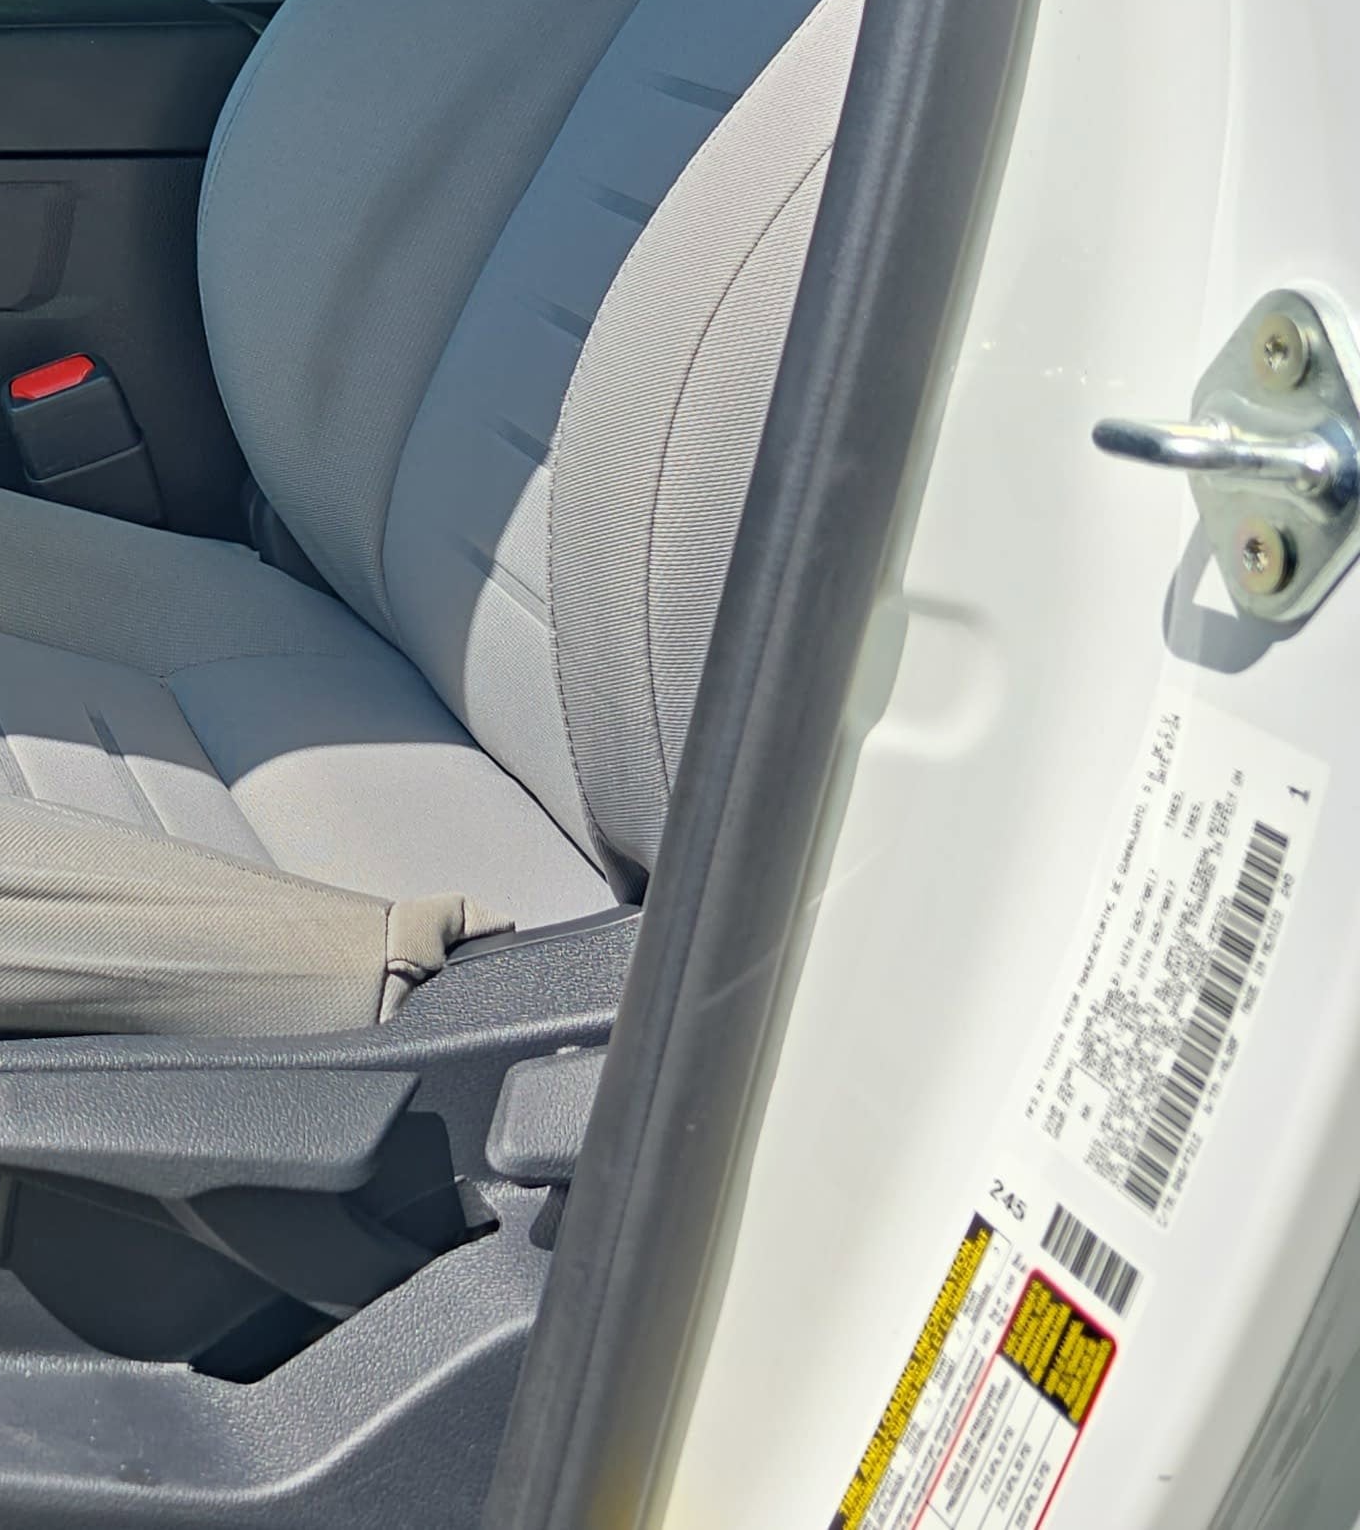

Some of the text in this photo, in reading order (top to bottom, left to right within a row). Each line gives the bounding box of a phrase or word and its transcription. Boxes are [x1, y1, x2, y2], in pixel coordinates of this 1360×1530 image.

[988, 1179, 1026, 1221] 245
[856, 1434, 882, 1478] AND
[875, 1356, 918, 1437] LOADING
[911, 1236, 973, 1359] INFORMATION
